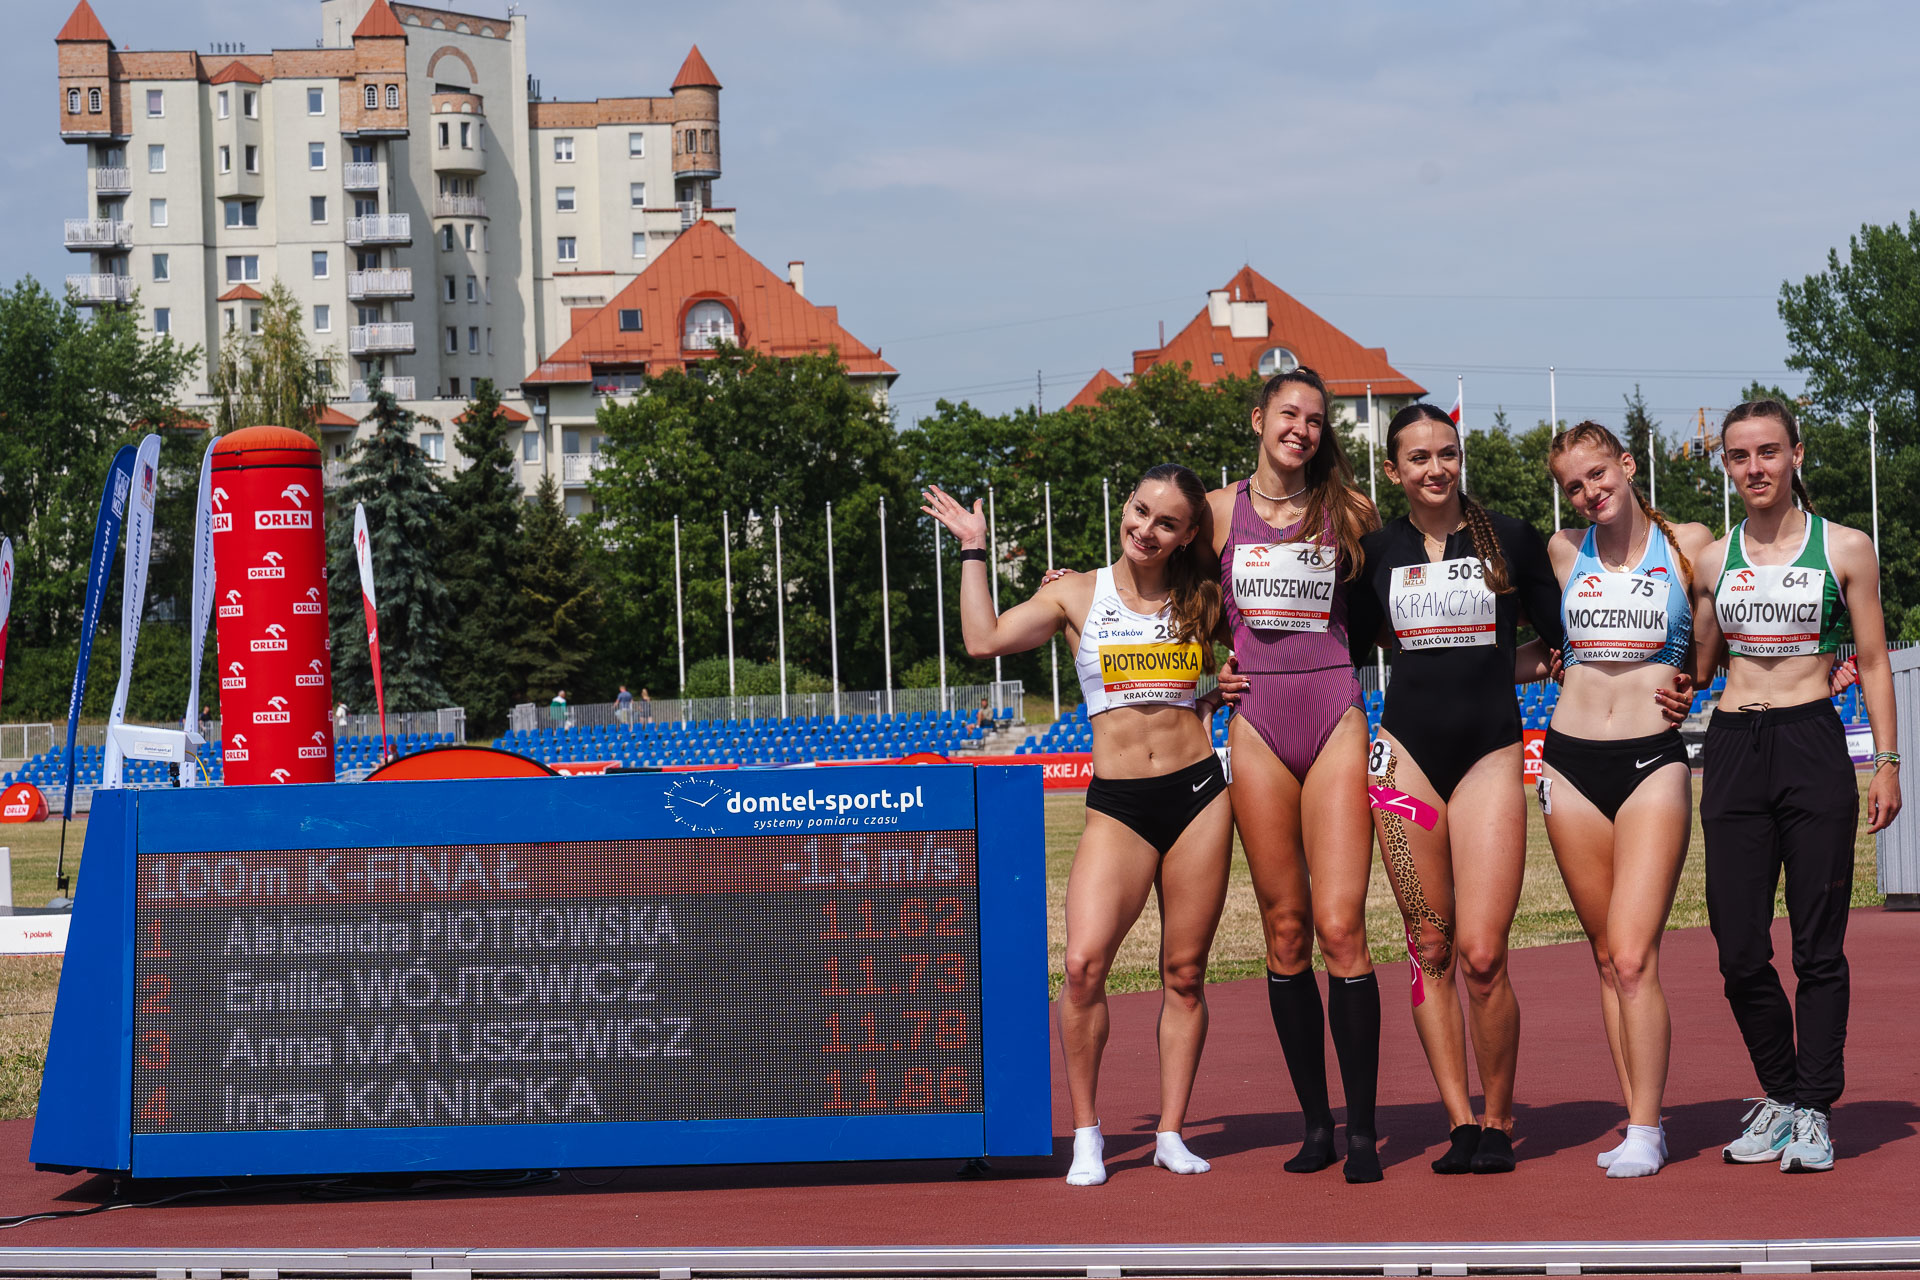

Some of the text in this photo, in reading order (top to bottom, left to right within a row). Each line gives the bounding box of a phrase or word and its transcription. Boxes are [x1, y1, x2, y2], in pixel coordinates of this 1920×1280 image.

[259, 513, 310, 526] ORLEN
[1296, 548, 1320, 566] 46
[250, 569, 282, 578] ORLEN
[1448, 564, 1484, 580] 503
[1782, 572, 1808, 588] 64
[1236, 578, 1332, 600] MATUSZEWICZ
[1630, 578, 1654, 597] 75
[220, 607, 240, 616] ORLEN
[295, 604, 320, 612] ORLEN
[1396, 590, 1494, 620] KRAWCZYK
[1720, 598, 1818, 622] WÓJTOWICZ
[1252, 618, 1290, 626] KRAKÓW
[1568, 609, 1664, 630] MOCZERNIUK
[1112, 629, 1143, 637] Kraków
[252, 641, 285, 650] ORLEN
[1412, 636, 1476, 646] KRAKÓW 2025
[1584, 649, 1620, 658] KRAKÓW
[1740, 645, 1800, 654] KRAKÓW 2025
[1103, 652, 1198, 673] PIOTROWSKA
[223, 679, 244, 688] ORLEN
[298, 676, 323, 684] ORLEN
[1124, 690, 1164, 700] KRAKÓW
[255, 714, 288, 722] ORLEN
[226, 751, 246, 760] ORLEN
[300, 748, 326, 756] ORLEN
[1370, 741, 1384, 772] 8
[726, 786, 924, 814] domtel-sport.pl
[1538, 780, 1547, 811] 4
[6, 806, 27, 814] ORLEN
[754, 815, 898, 829] systemy pomiaru czasu
[147, 858, 288, 899] 100m
[308, 851, 528, 895] K-FINAŁ
[881, 834, 960, 882] m/s
[144, 918, 171, 958] 1
[423, 906, 680, 951] PIOTROWSKA
[820, 897, 964, 940] 11.62
[30, 930, 52, 939] polanik
[142, 953, 966, 1014] 2 Emilia WÓJTOWICZ 11.73
[139, 1010, 968, 1069] 3 Anna MATUSZEWICZ 11.78
[140, 1066, 969, 1130] 4 Inga KANICKA 11.86
